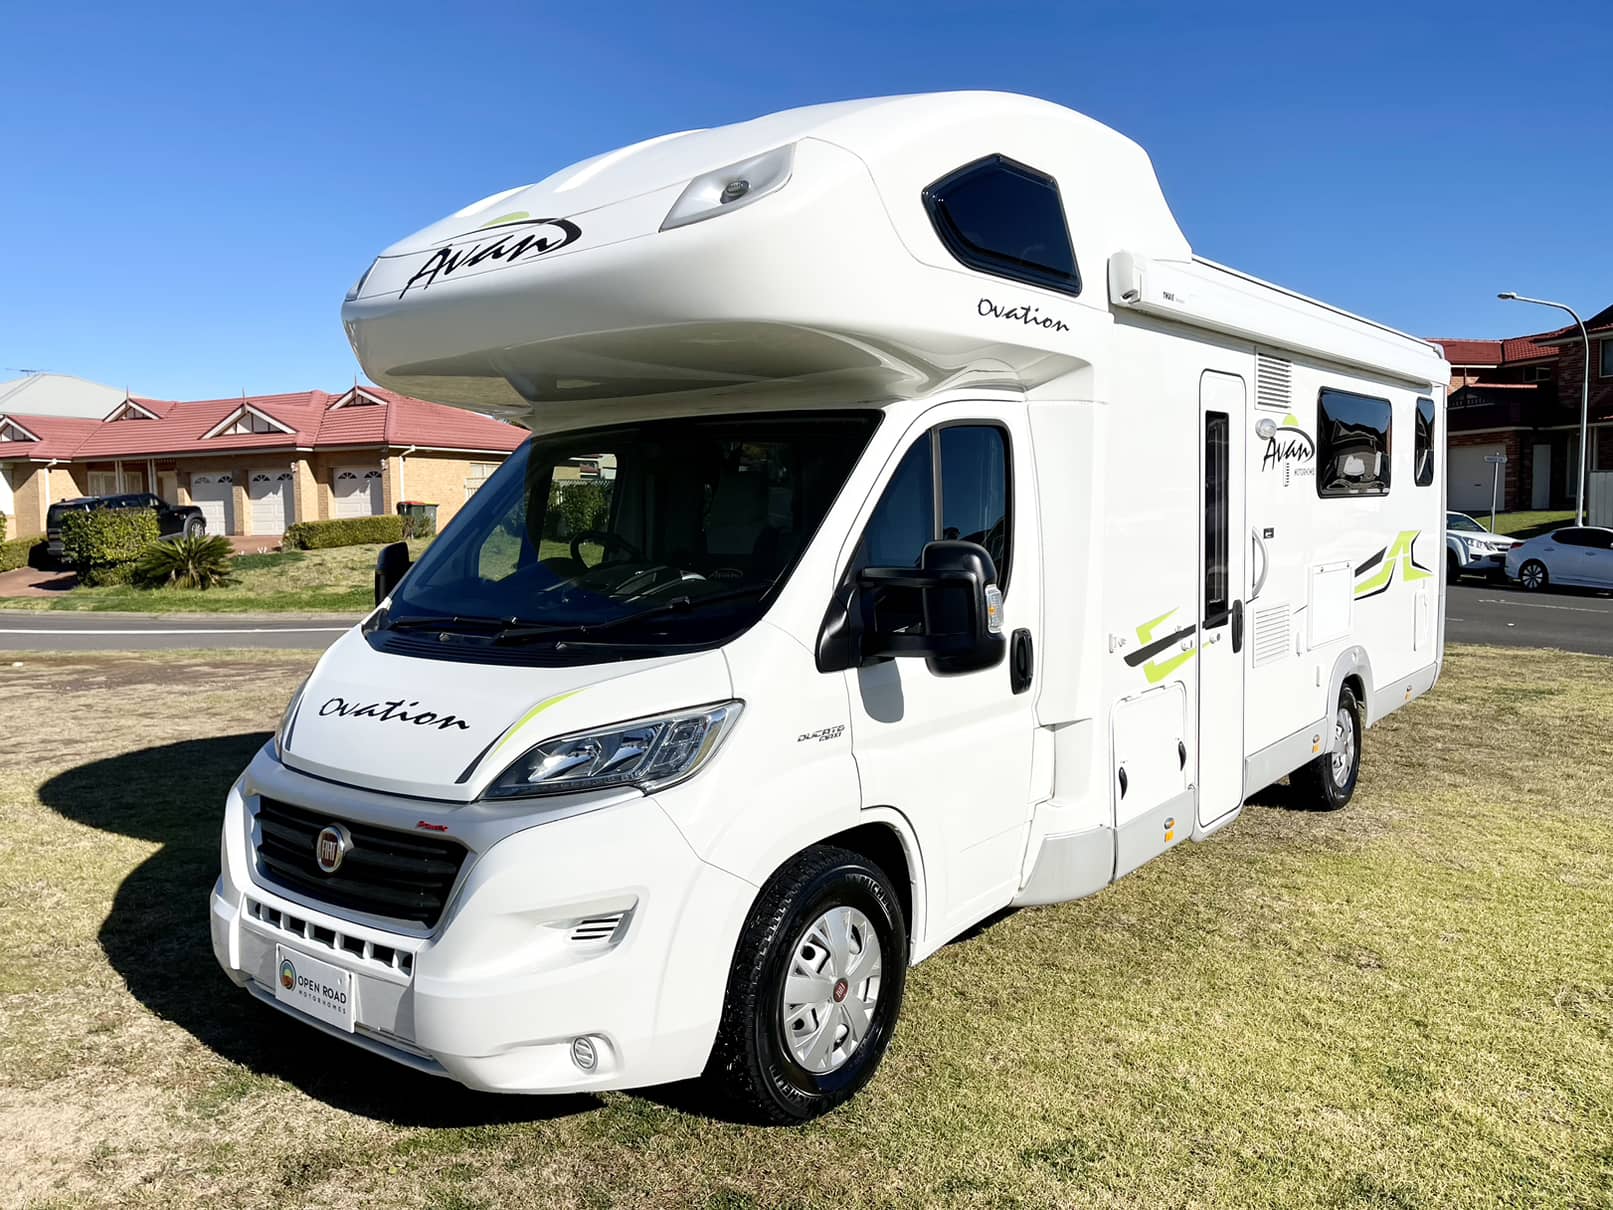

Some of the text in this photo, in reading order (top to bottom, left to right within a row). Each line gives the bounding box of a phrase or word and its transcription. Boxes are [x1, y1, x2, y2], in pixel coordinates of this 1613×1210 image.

[399, 232, 563, 300] Avan
[977, 298, 1070, 332] Ovation
[1261, 436, 1312, 473] Avan
[319, 697, 471, 730] Ovation
[321, 839, 337, 861] FIAT
[297, 975, 347, 1004] OPEN ROAD
